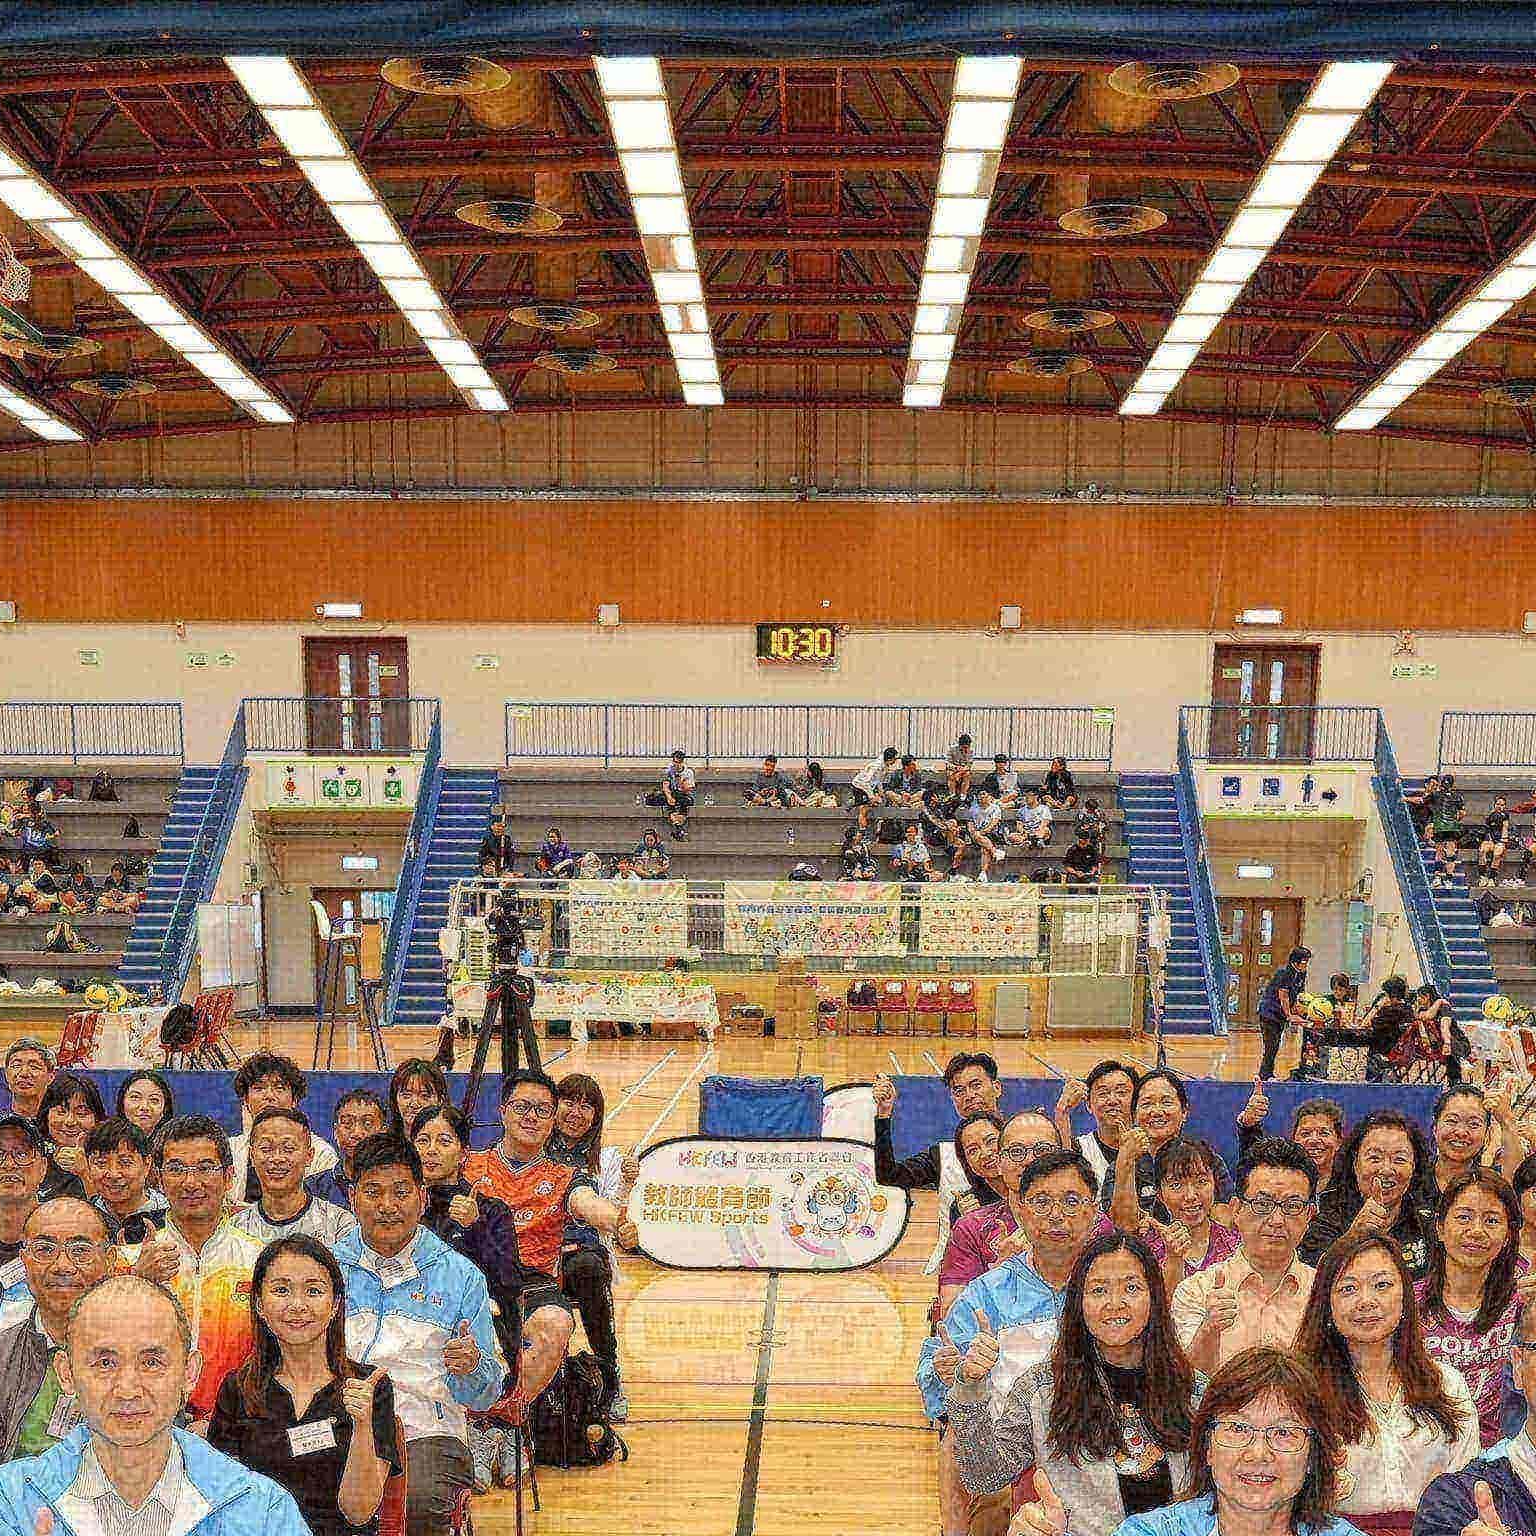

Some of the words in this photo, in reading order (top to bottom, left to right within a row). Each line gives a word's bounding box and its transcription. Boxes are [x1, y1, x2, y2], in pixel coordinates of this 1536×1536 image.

[769, 627, 833, 658] 10:30
[643, 1209, 704, 1224] HKFEW
[710, 1210, 769, 1226] Sports
